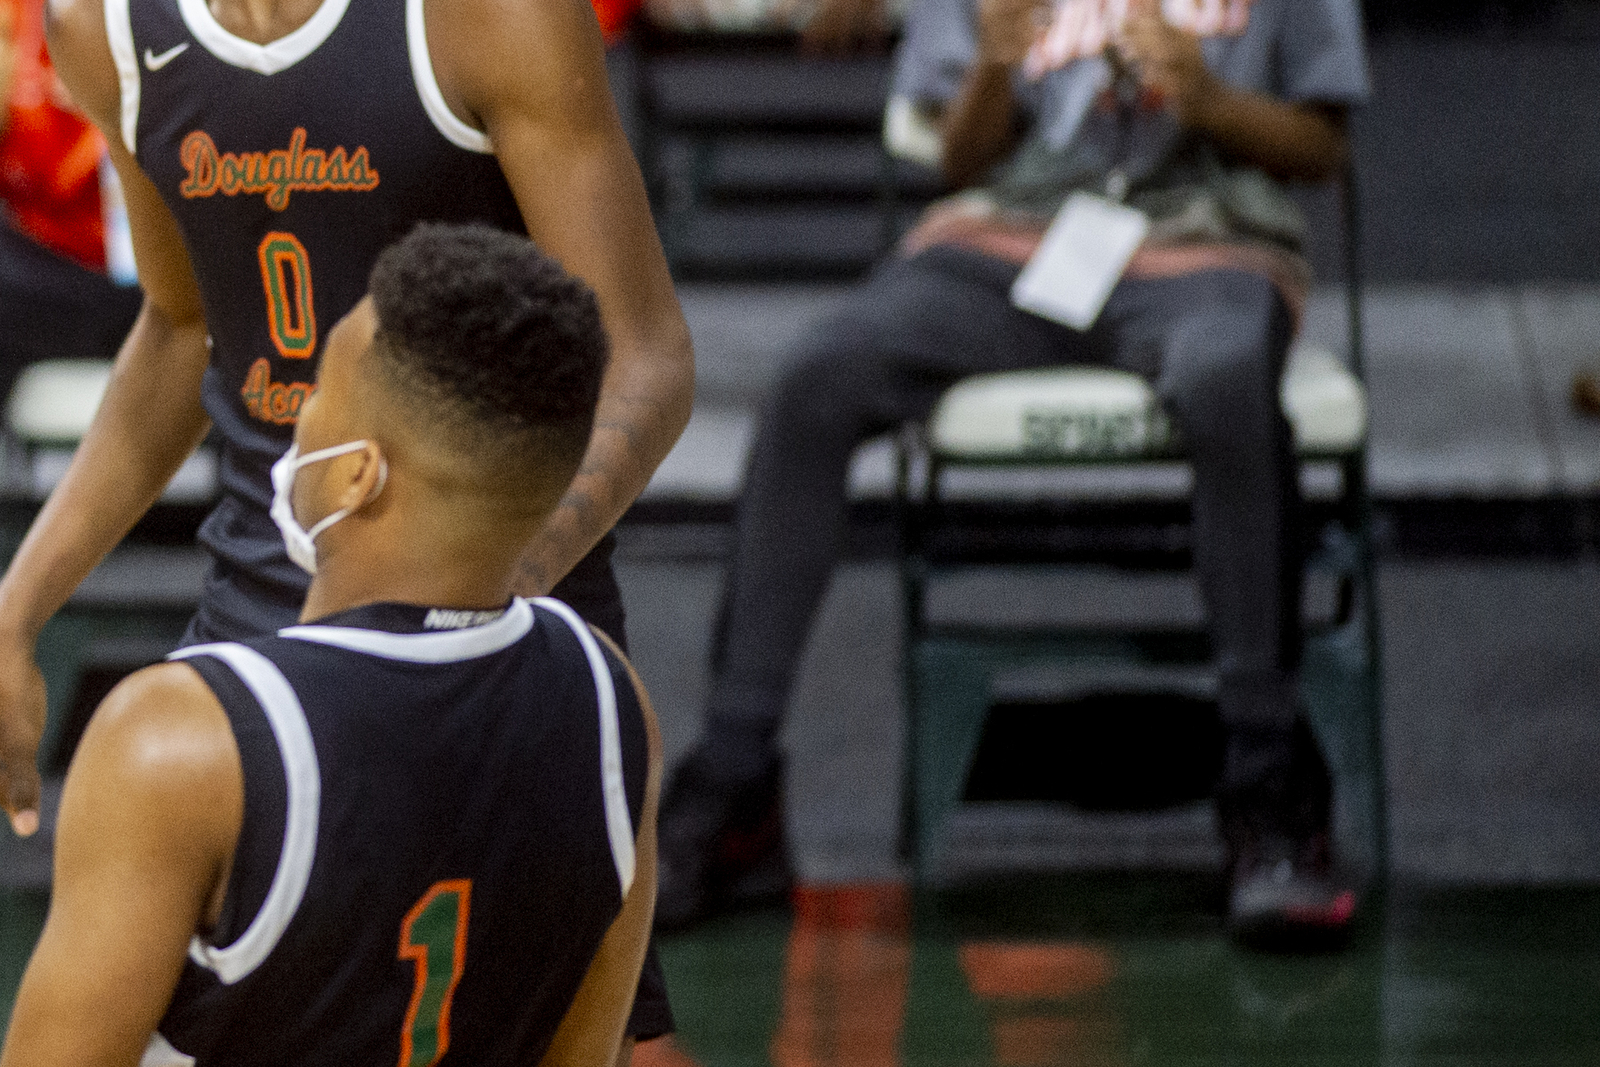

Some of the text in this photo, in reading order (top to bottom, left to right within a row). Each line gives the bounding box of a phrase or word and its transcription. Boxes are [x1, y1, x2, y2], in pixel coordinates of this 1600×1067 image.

[180, 127, 380, 212] Douglass
[257, 231, 317, 359] 0
[396, 878, 472, 1067] 1
